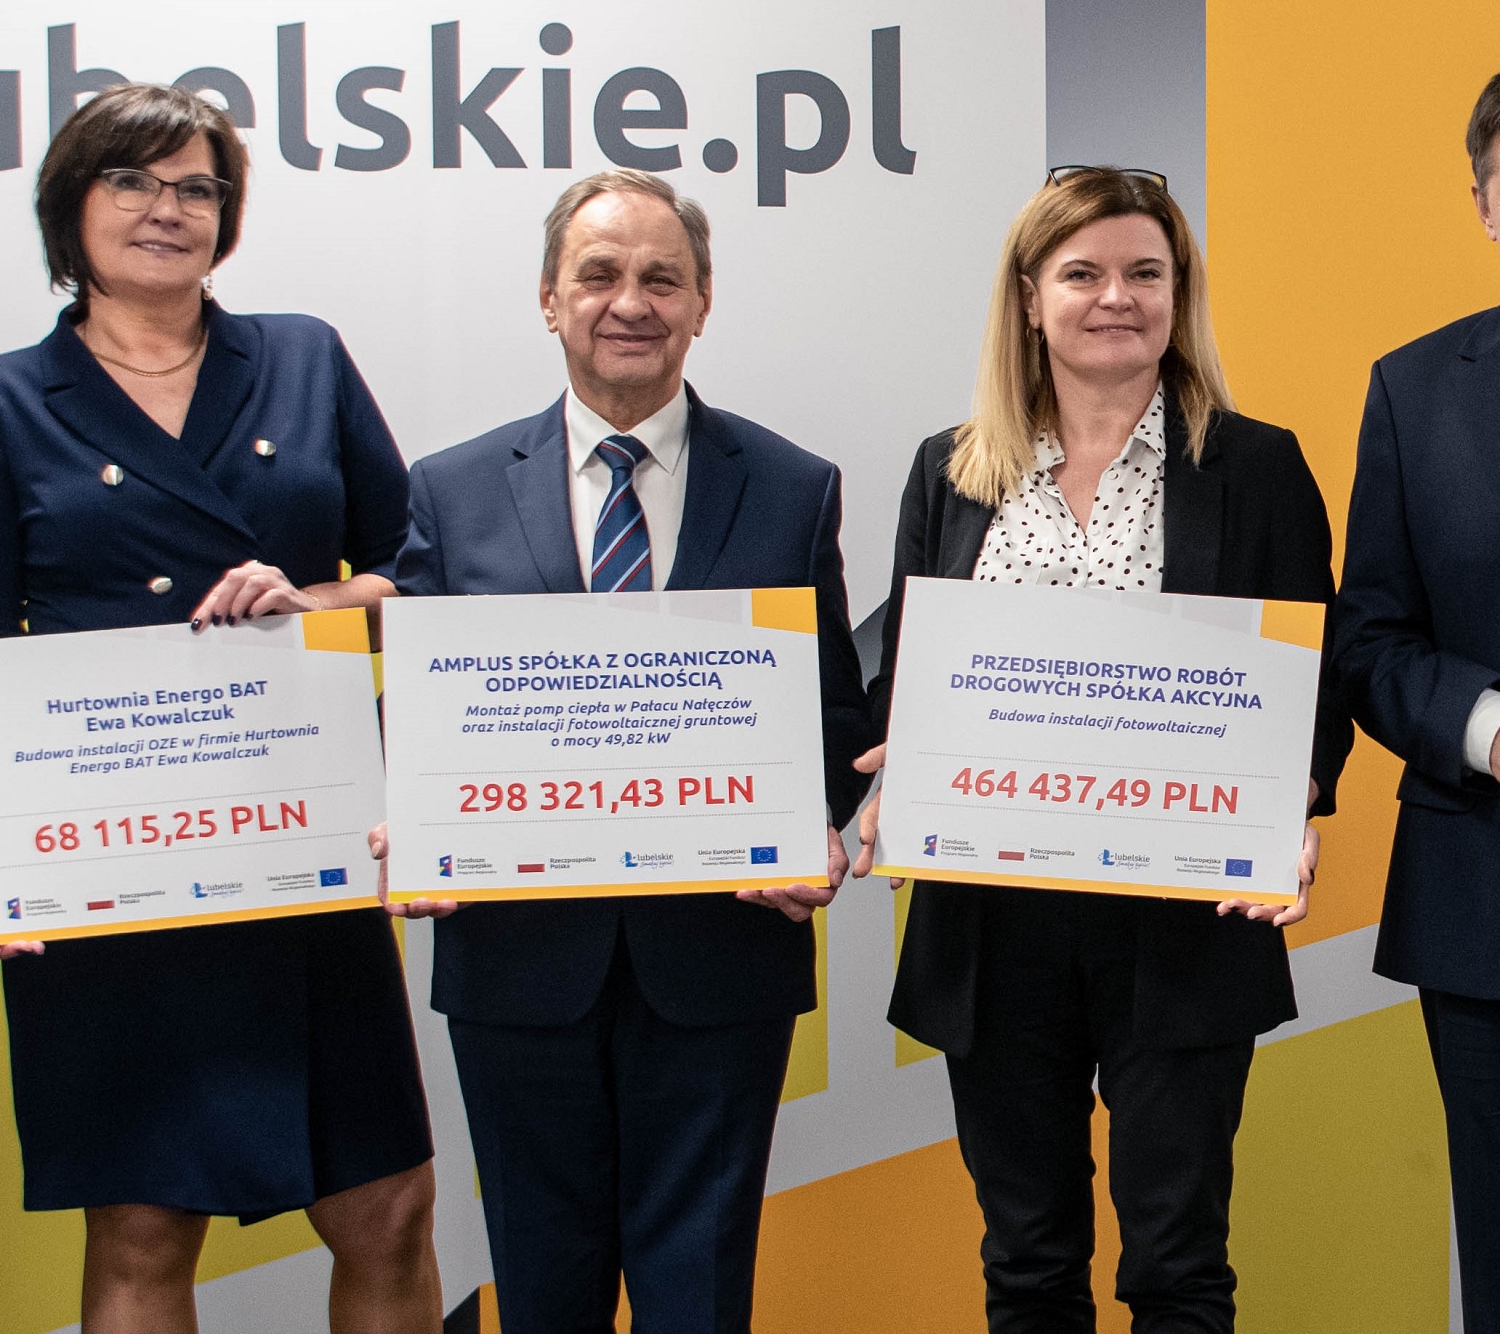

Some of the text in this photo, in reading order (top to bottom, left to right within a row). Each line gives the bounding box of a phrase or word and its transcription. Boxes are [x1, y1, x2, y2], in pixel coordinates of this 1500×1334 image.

[428, 649, 777, 673] AMPLUS SPÓŁKA OGRANICZONĄ
[971, 654, 1247, 687] PRZEDSIĘBIORSTWO ROBÓT
[485, 667, 724, 693] ODPOWIEDZIALNOŚCIĄ
[950, 673, 1263, 710] DROGOWYCH SPÓŁKA AKCYJNA
[47, 680, 268, 715] Hurtownia Energo BAT
[465, 696, 753, 718] Montaż pomp ciepła Pałacu Nałęczów
[86, 703, 235, 732] Ewa Kowalczuk
[462, 712, 758, 734] oraz instalacji fotowoltaicznej gruntowej
[988, 708, 1228, 739] Budowa instalacji fotowoltaicznej
[14, 723, 320, 763] Budowa instalacji OZE firmie Hurtownia
[563, 731, 672, 749] mocy 49,82 kW
[69, 743, 270, 774] Energo BAT Ewa Kowalczuk
[459, 775, 754, 814] 298 321,43 PLN
[951, 767, 1239, 815] 464 437,49 PLN
[34, 800, 308, 853] 68 115,25 PLN
